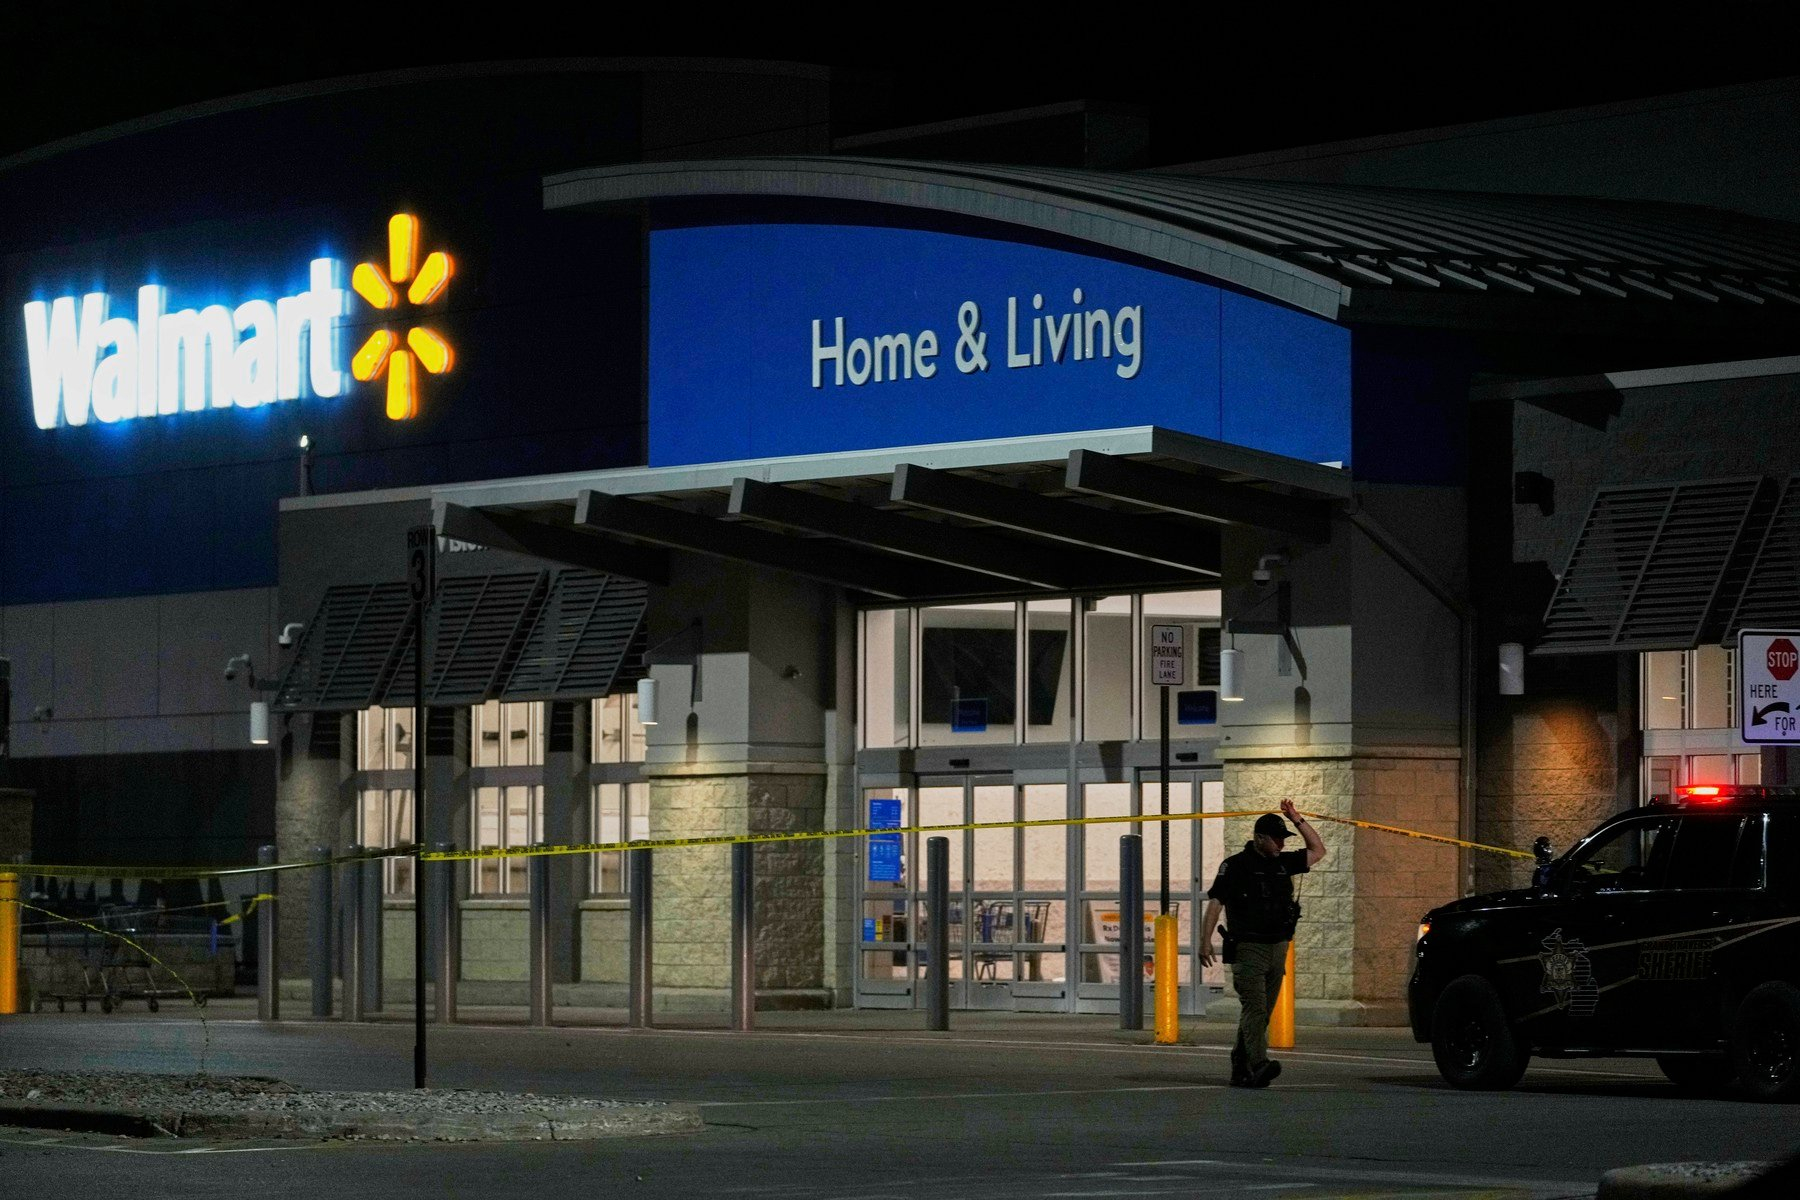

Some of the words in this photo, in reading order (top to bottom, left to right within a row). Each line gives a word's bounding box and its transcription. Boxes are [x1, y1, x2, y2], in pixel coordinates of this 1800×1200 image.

[24, 258, 348, 429] Walmart
[812, 317, 938, 388] Home
[955, 301, 988, 374] &
[1008, 288, 1142, 379] Living
[408, 529, 428, 549] ROW
[411, 549, 426, 601] 3
[1161, 631, 1174, 643] NO
[1153, 646, 1182, 657] PARKING
[1160, 660, 1175, 669] FIRE
[1768, 651, 1798, 668] STOP
[1159, 671, 1176, 680] LANE
[1750, 684, 1778, 698] HERE
[1775, 717, 1796, 731] FOR
[1637, 951, 1712, 979] SHERIFF
